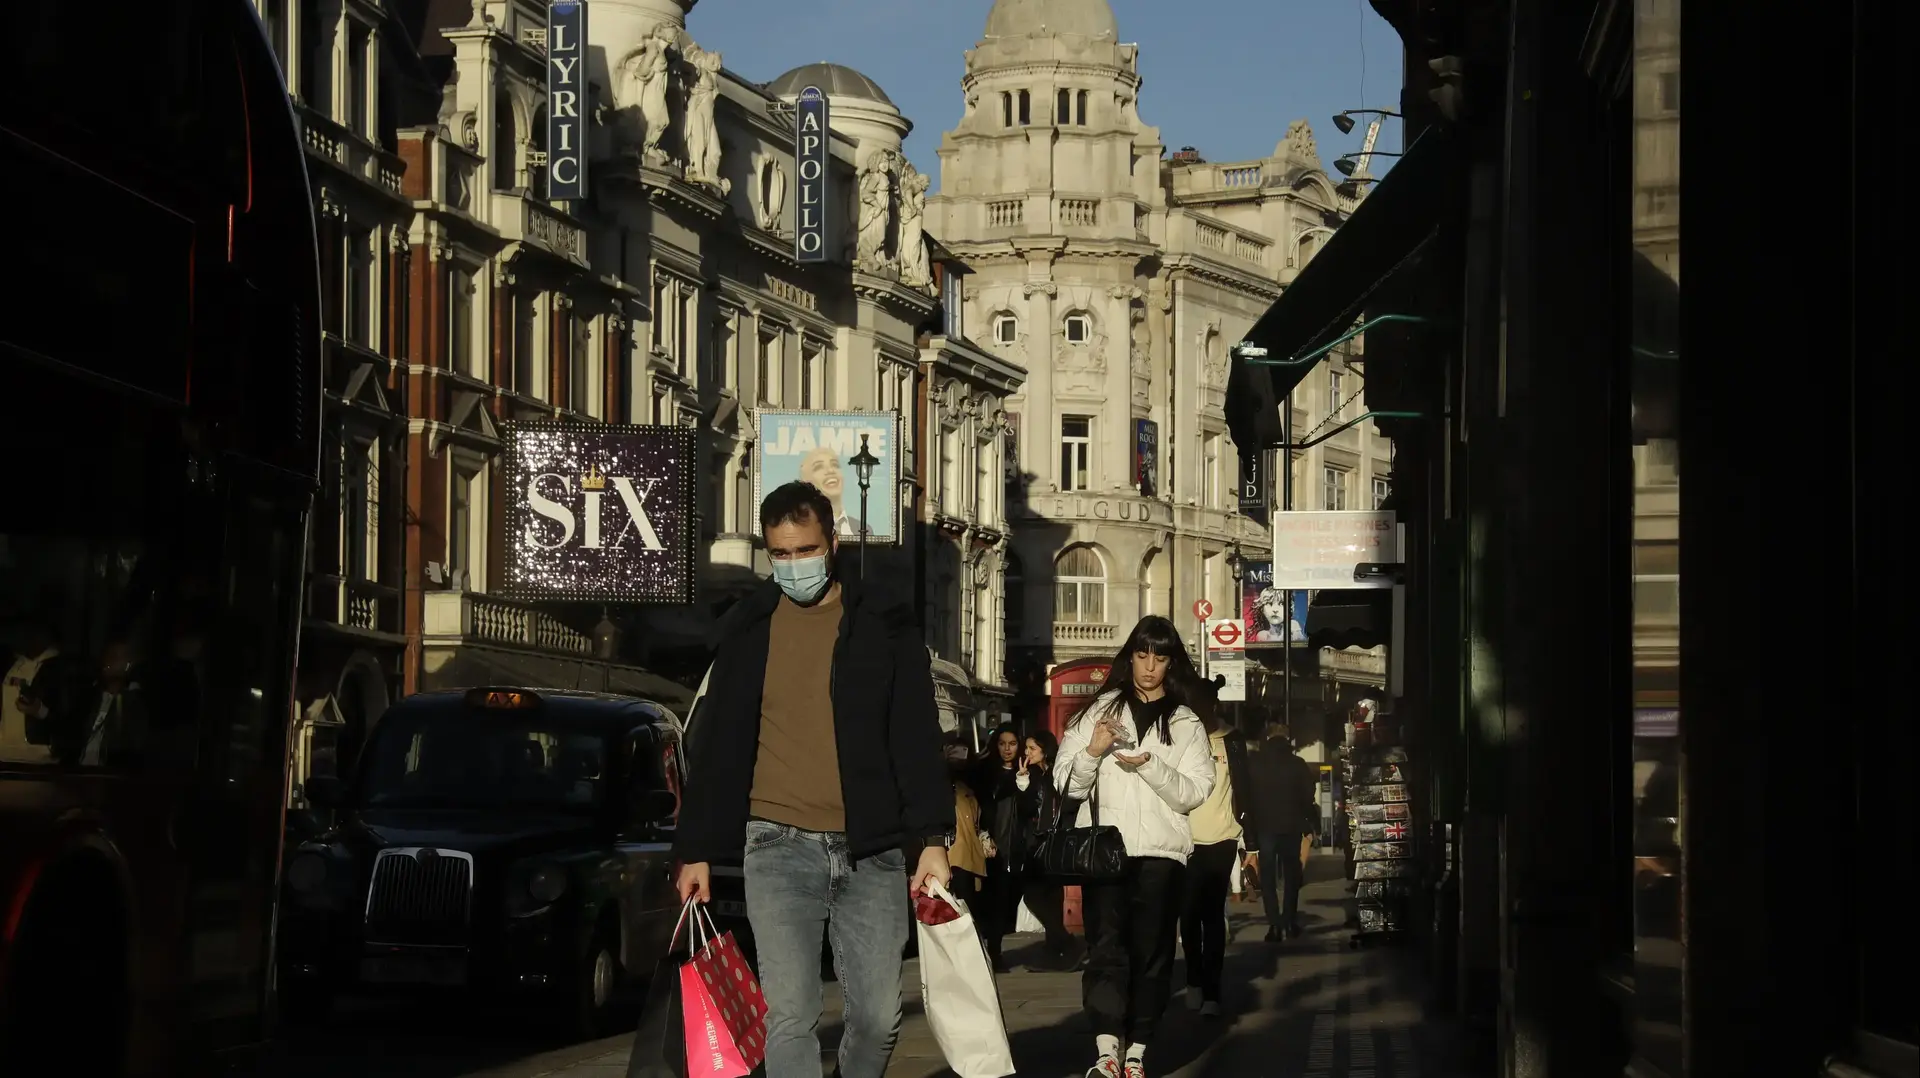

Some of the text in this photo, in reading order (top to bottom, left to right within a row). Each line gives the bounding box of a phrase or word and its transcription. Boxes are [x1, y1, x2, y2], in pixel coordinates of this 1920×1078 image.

[551, 25, 578, 184] LYRIC
[800, 112, 821, 252] APOLLO
[769, 276, 817, 311] THEATRE
[764, 426, 886, 456] JAMIE
[525, 473, 668, 550] SIX
[1198, 602, 1209, 616] K
[1065, 685, 1100, 695] TELEP
[706, 1020, 724, 1071] SECRET PINK
